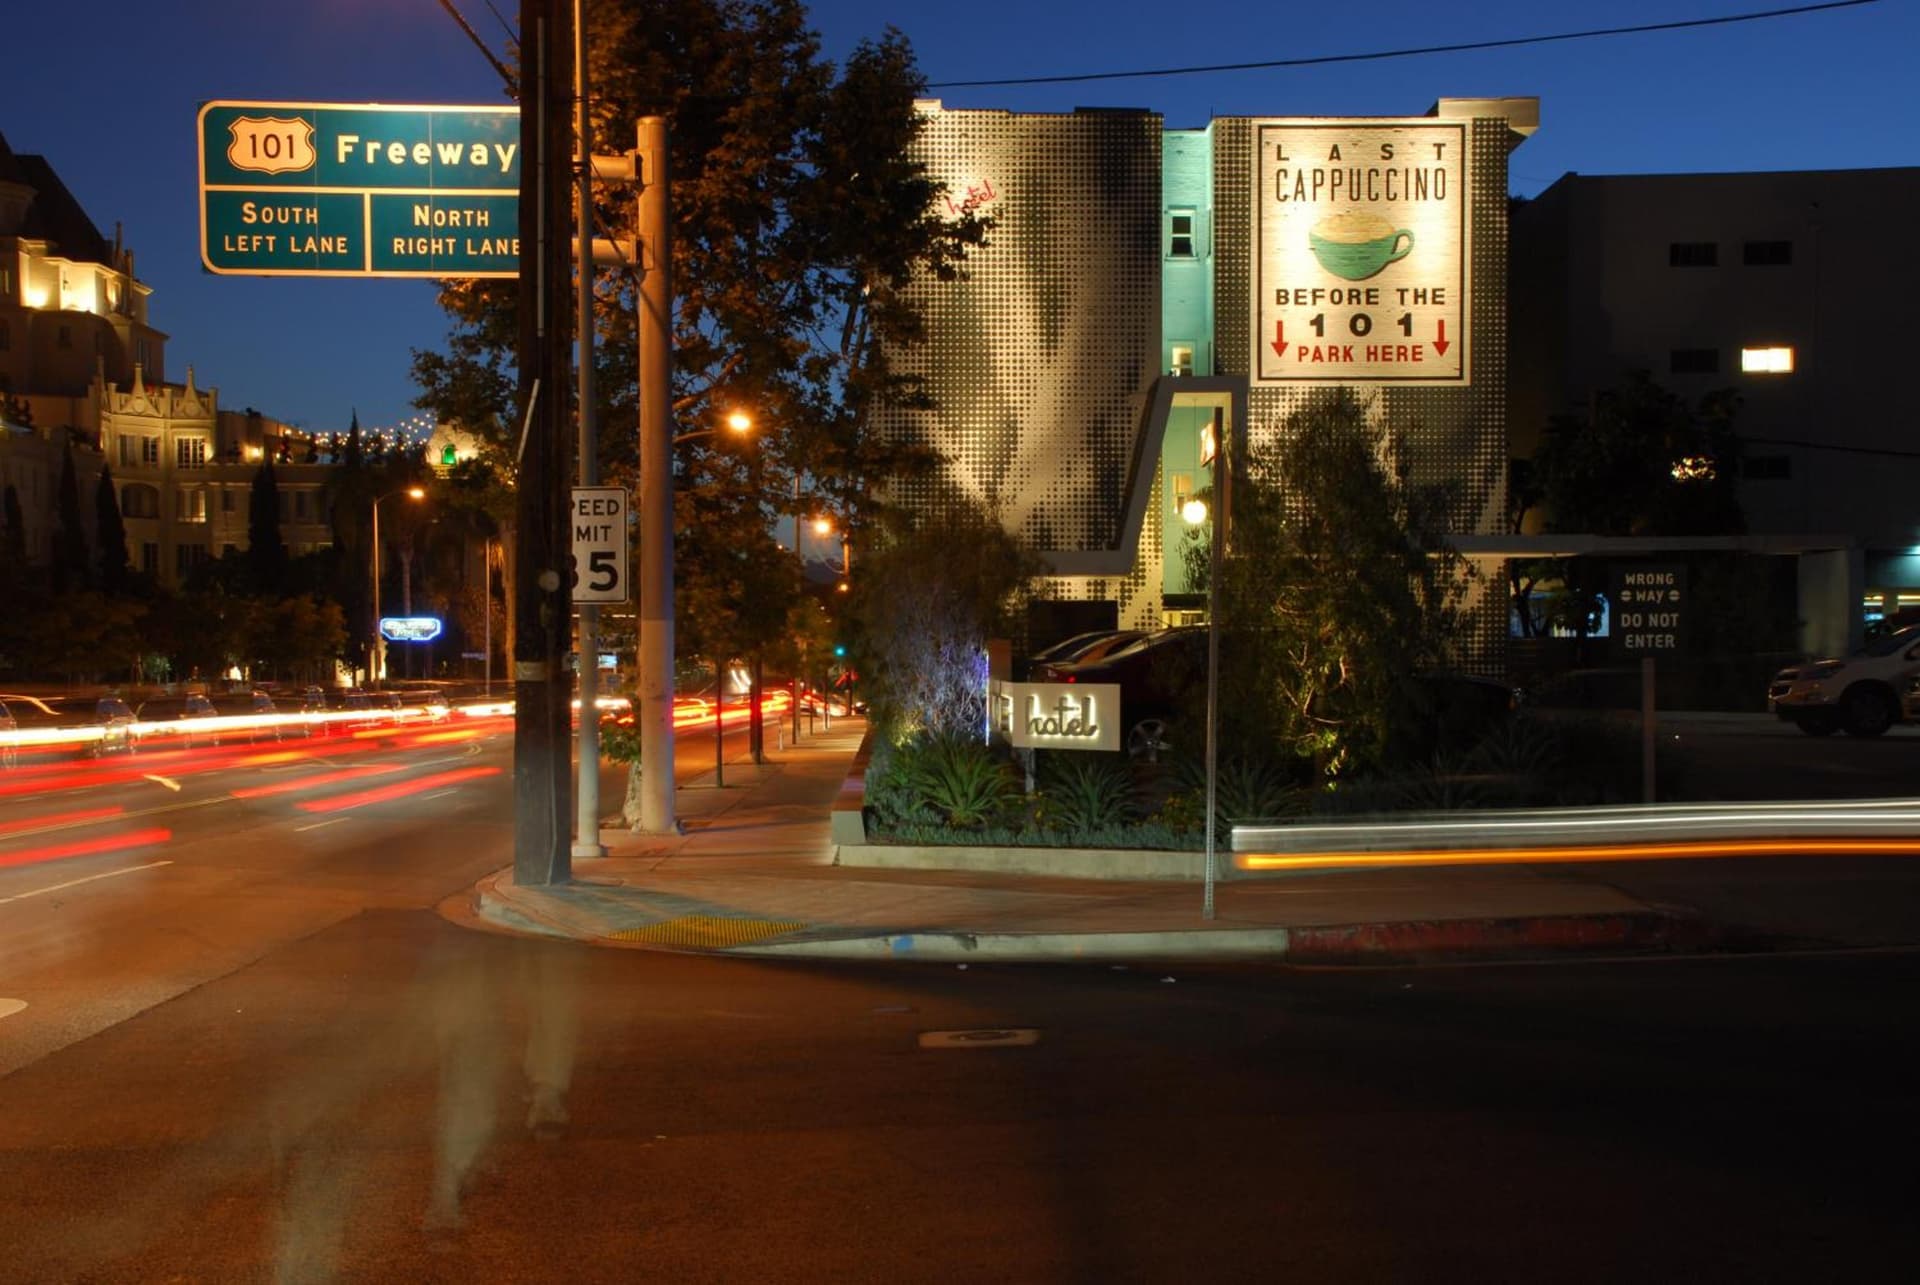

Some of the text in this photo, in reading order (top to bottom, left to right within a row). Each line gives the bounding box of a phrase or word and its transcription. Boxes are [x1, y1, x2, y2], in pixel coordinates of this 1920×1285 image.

[249, 133, 517, 173] 101 Freeway
[1275, 143, 1447, 162] LAST
[1275, 167, 1447, 202] CAPPUCCINO
[241, 202, 319, 224] SOUTH
[413, 205, 490, 227] NORTH
[224, 235, 348, 253] LEFT LANE
[393, 238, 520, 256] RIGHT LANE
[1275, 288, 1446, 305] BEFORE THE
[1309, 312, 1414, 338] 101
[1298, 345, 1424, 362] PARK HERE
[572, 499, 620, 516] EED
[576, 525, 612, 542] MIT
[572, 551, 619, 592] 5
[1625, 573, 1674, 585] WRONG
[1636, 590, 1665, 603] WAY
[1621, 613, 1679, 627] DO NOT
[1625, 634, 1675, 648] ENTER
[1025, 694, 1099, 737] hotel
